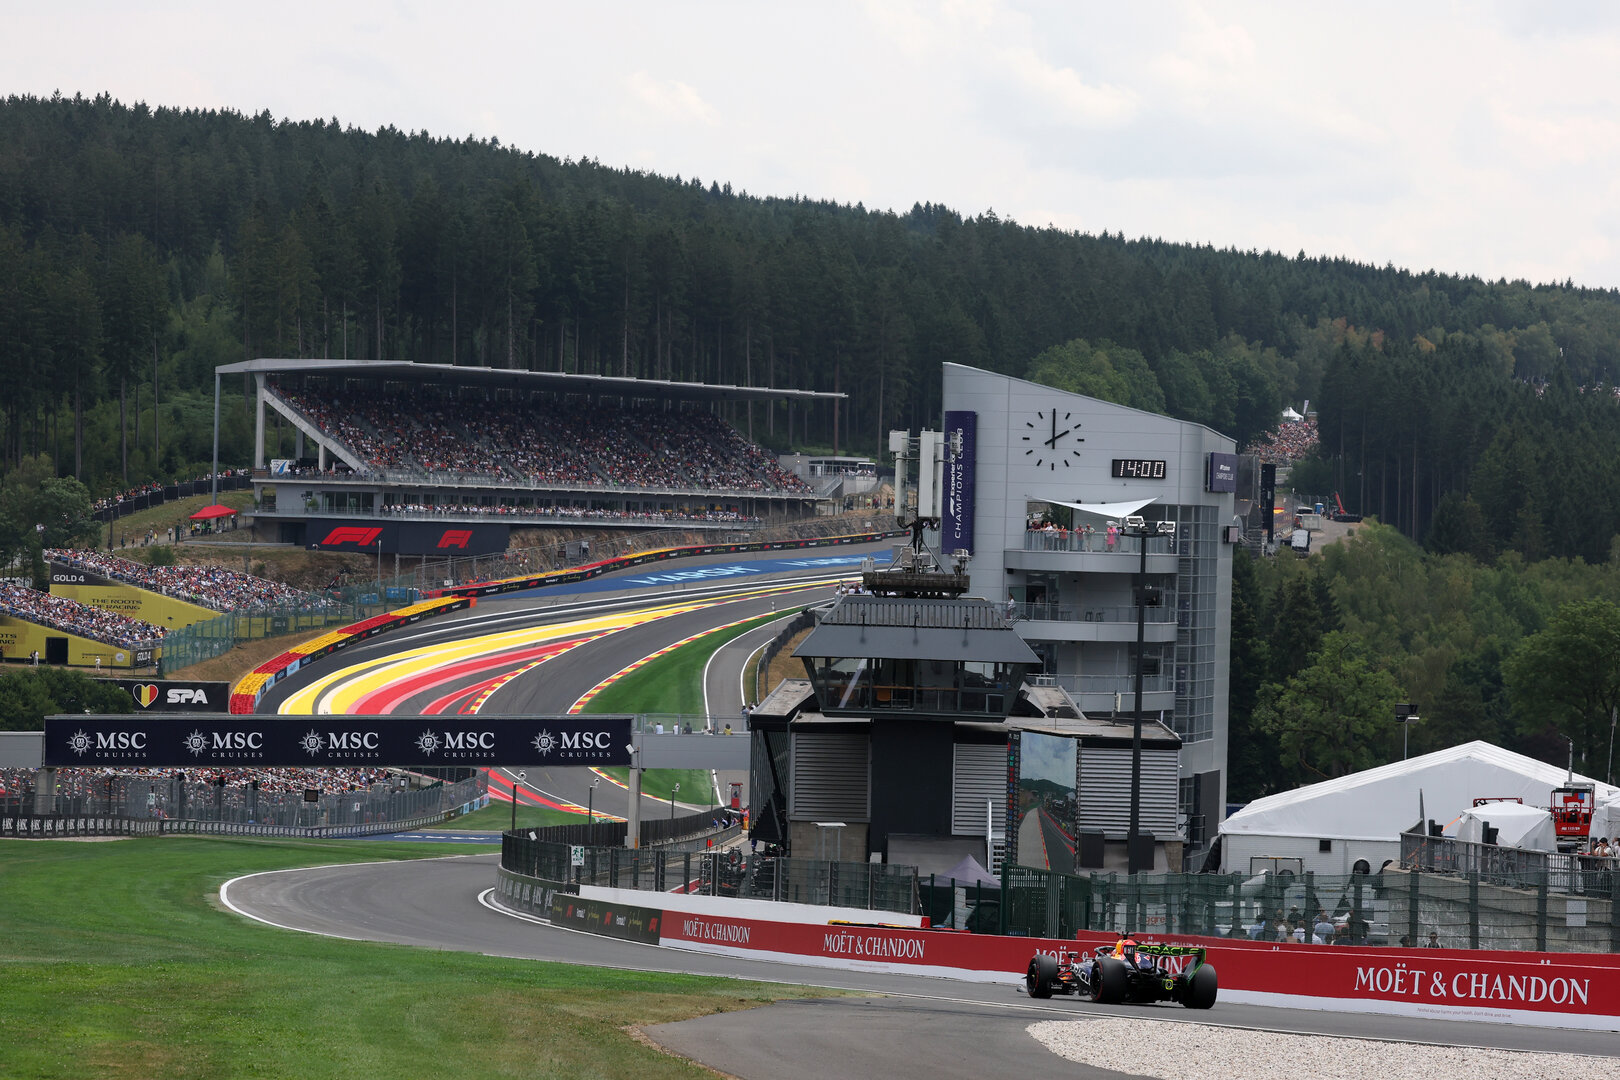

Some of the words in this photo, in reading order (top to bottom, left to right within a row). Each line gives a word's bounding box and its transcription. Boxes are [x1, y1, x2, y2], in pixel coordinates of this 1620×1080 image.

[1120, 461, 1164, 477] 14:00
[954, 463, 963, 538] CHAMPIONS
[53, 574, 77, 582] GOLD
[167, 688, 208, 704] SPA
[96, 732, 147, 749] MSC
[212, 732, 263, 749] MSC
[328, 732, 379, 749] MSC
[444, 732, 495, 749] MSC
[560, 732, 611, 749] MSC
[683, 917, 704, 938] MOËT
[704, 924, 711, 939] &
[711, 923, 751, 943] CHANDON
[823, 931, 855, 953] MOËT
[856, 936, 864, 954] &
[865, 936, 925, 959] CHANDON
[1135, 945, 1200, 956] ORACLE
[1354, 963, 1426, 995] MOËT
[1430, 971, 1447, 998] &
[1452, 972, 1590, 1006] CHANDON
